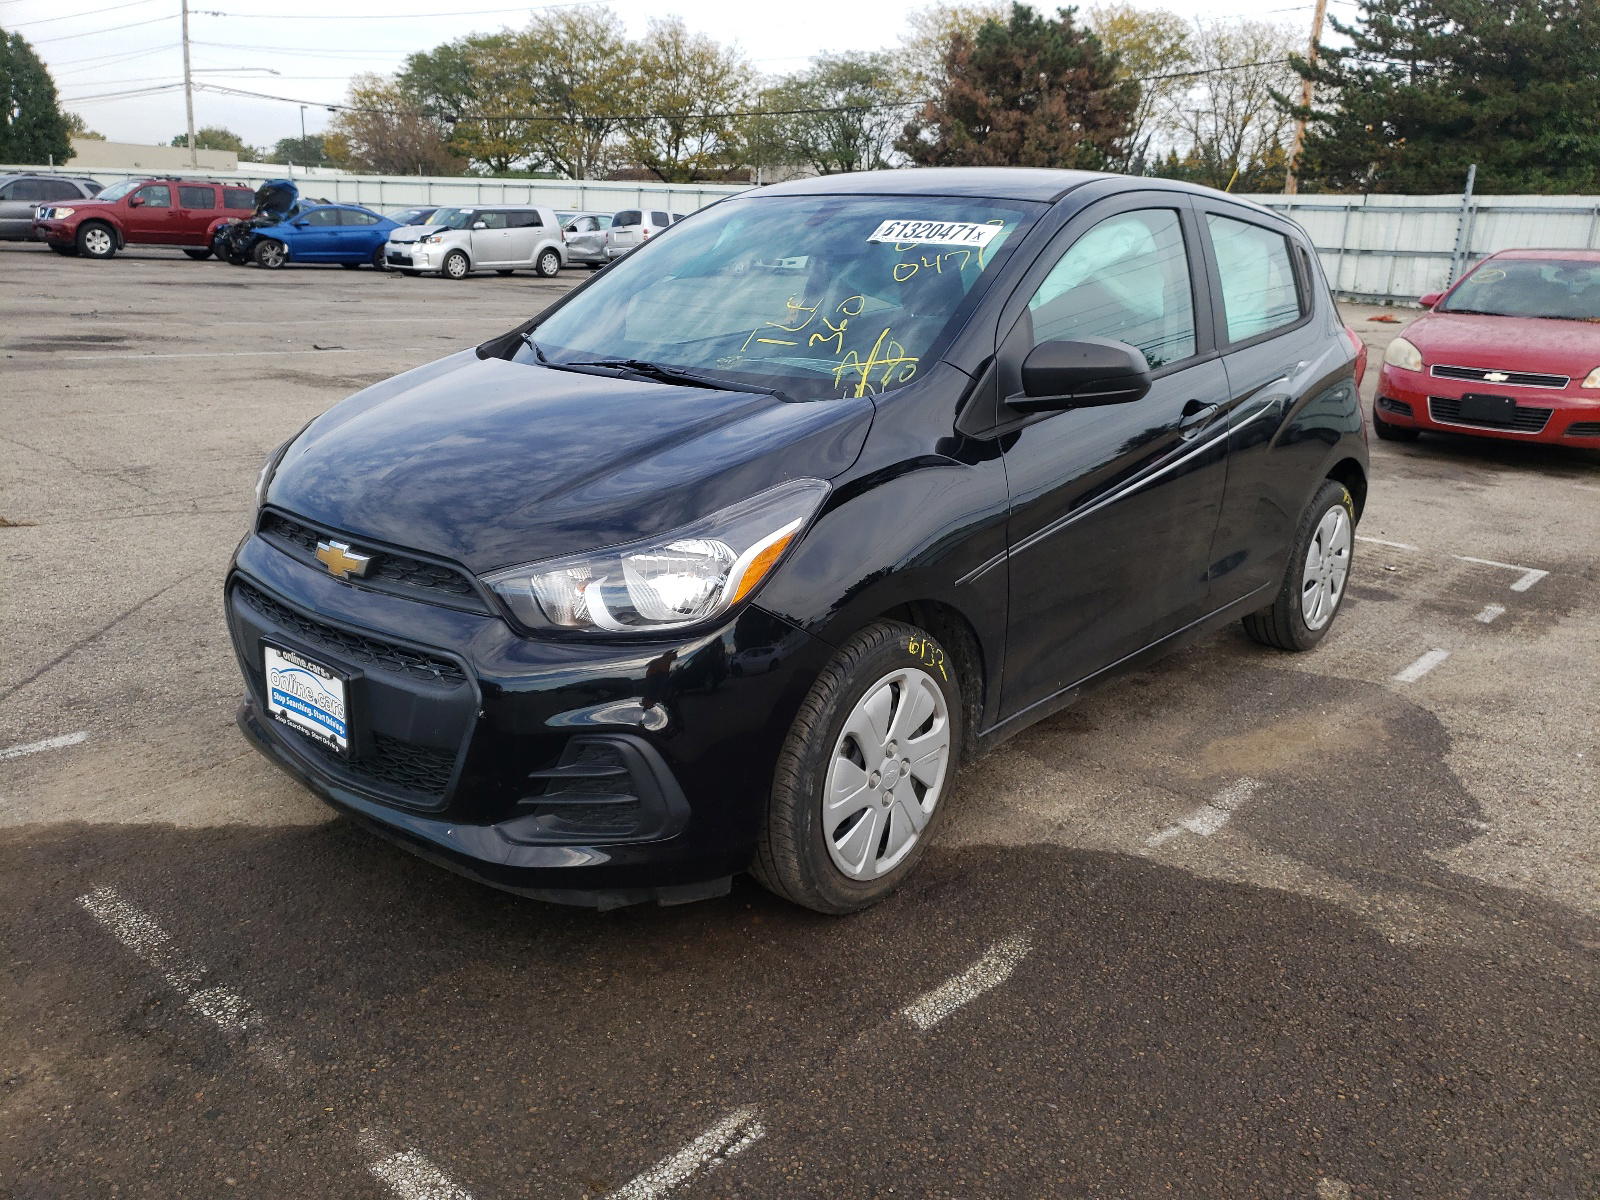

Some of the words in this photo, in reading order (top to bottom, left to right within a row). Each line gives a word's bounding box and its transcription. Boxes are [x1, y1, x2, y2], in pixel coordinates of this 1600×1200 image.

[282, 651, 328, 678] online.cars
[271, 671, 345, 720] online.cars
[273, 691, 286, 704] Stop
[314, 709, 326, 722] Start
[275, 714, 287, 725] Stop
[311, 730, 323, 742] Start
